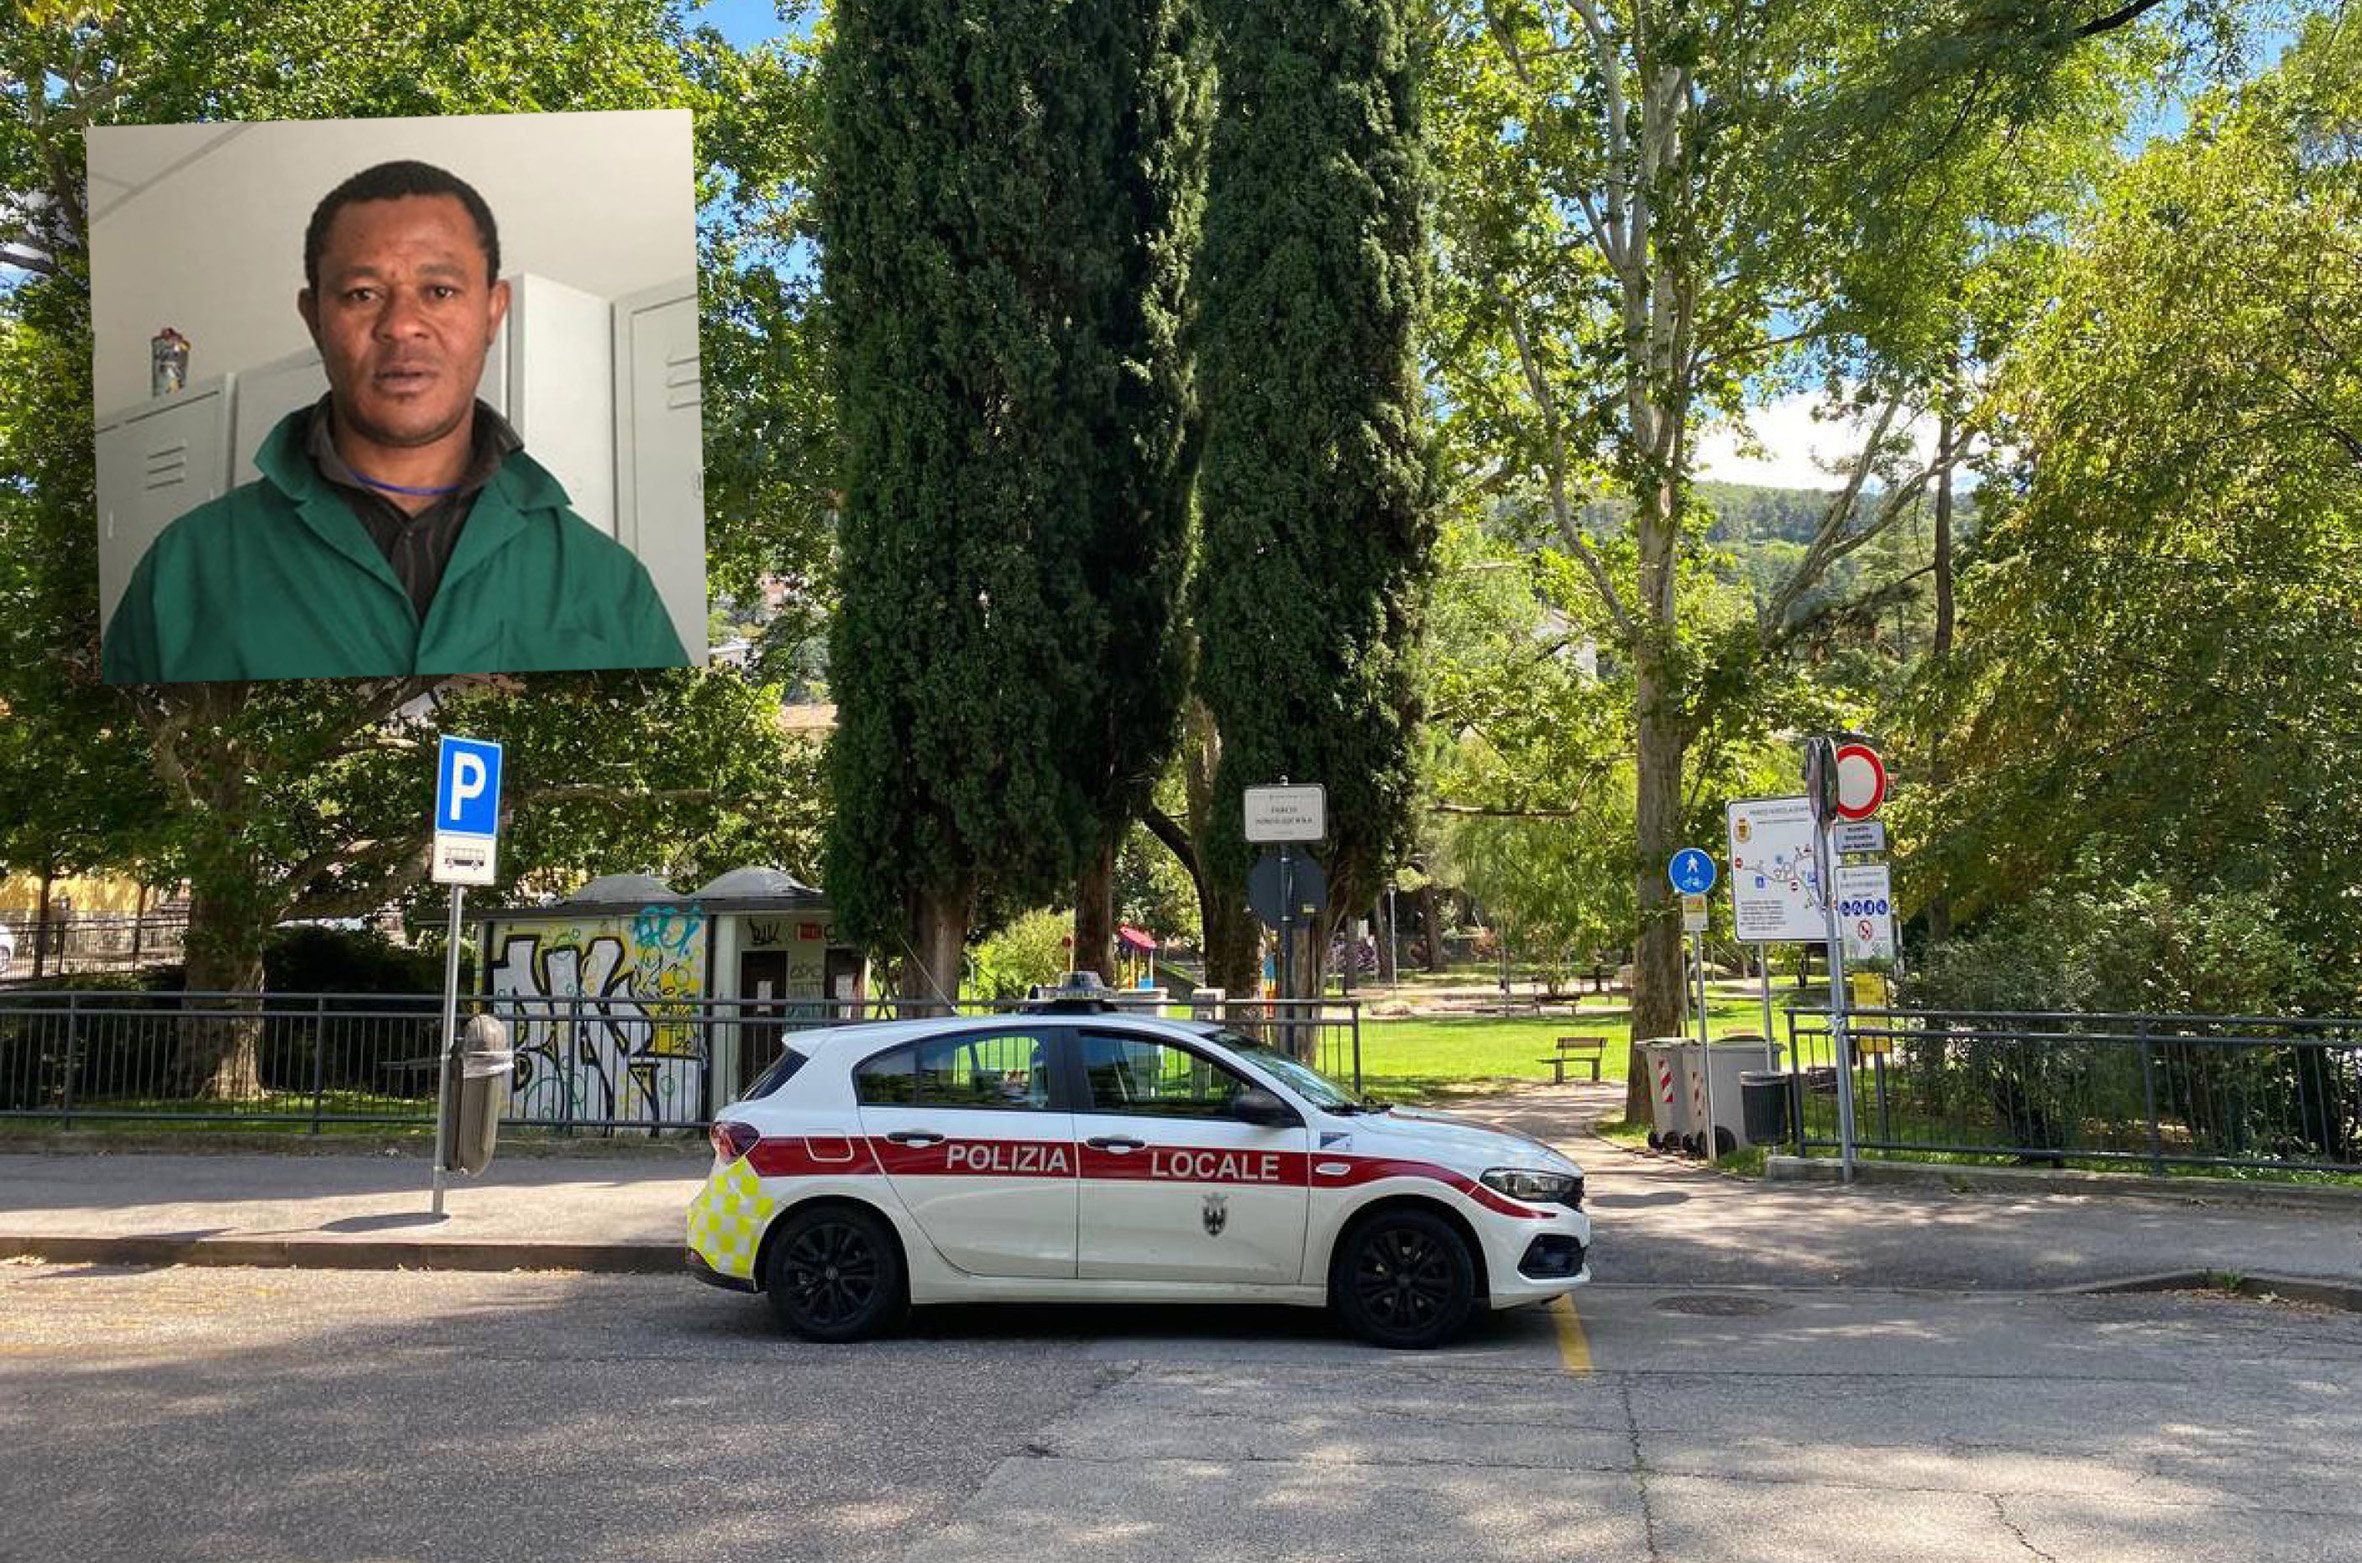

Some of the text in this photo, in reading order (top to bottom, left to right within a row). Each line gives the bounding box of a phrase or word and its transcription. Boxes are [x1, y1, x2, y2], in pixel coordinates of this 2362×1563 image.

[450, 752, 486, 821] P
[946, 1144, 1280, 1181] POLIZIA LOCALE
